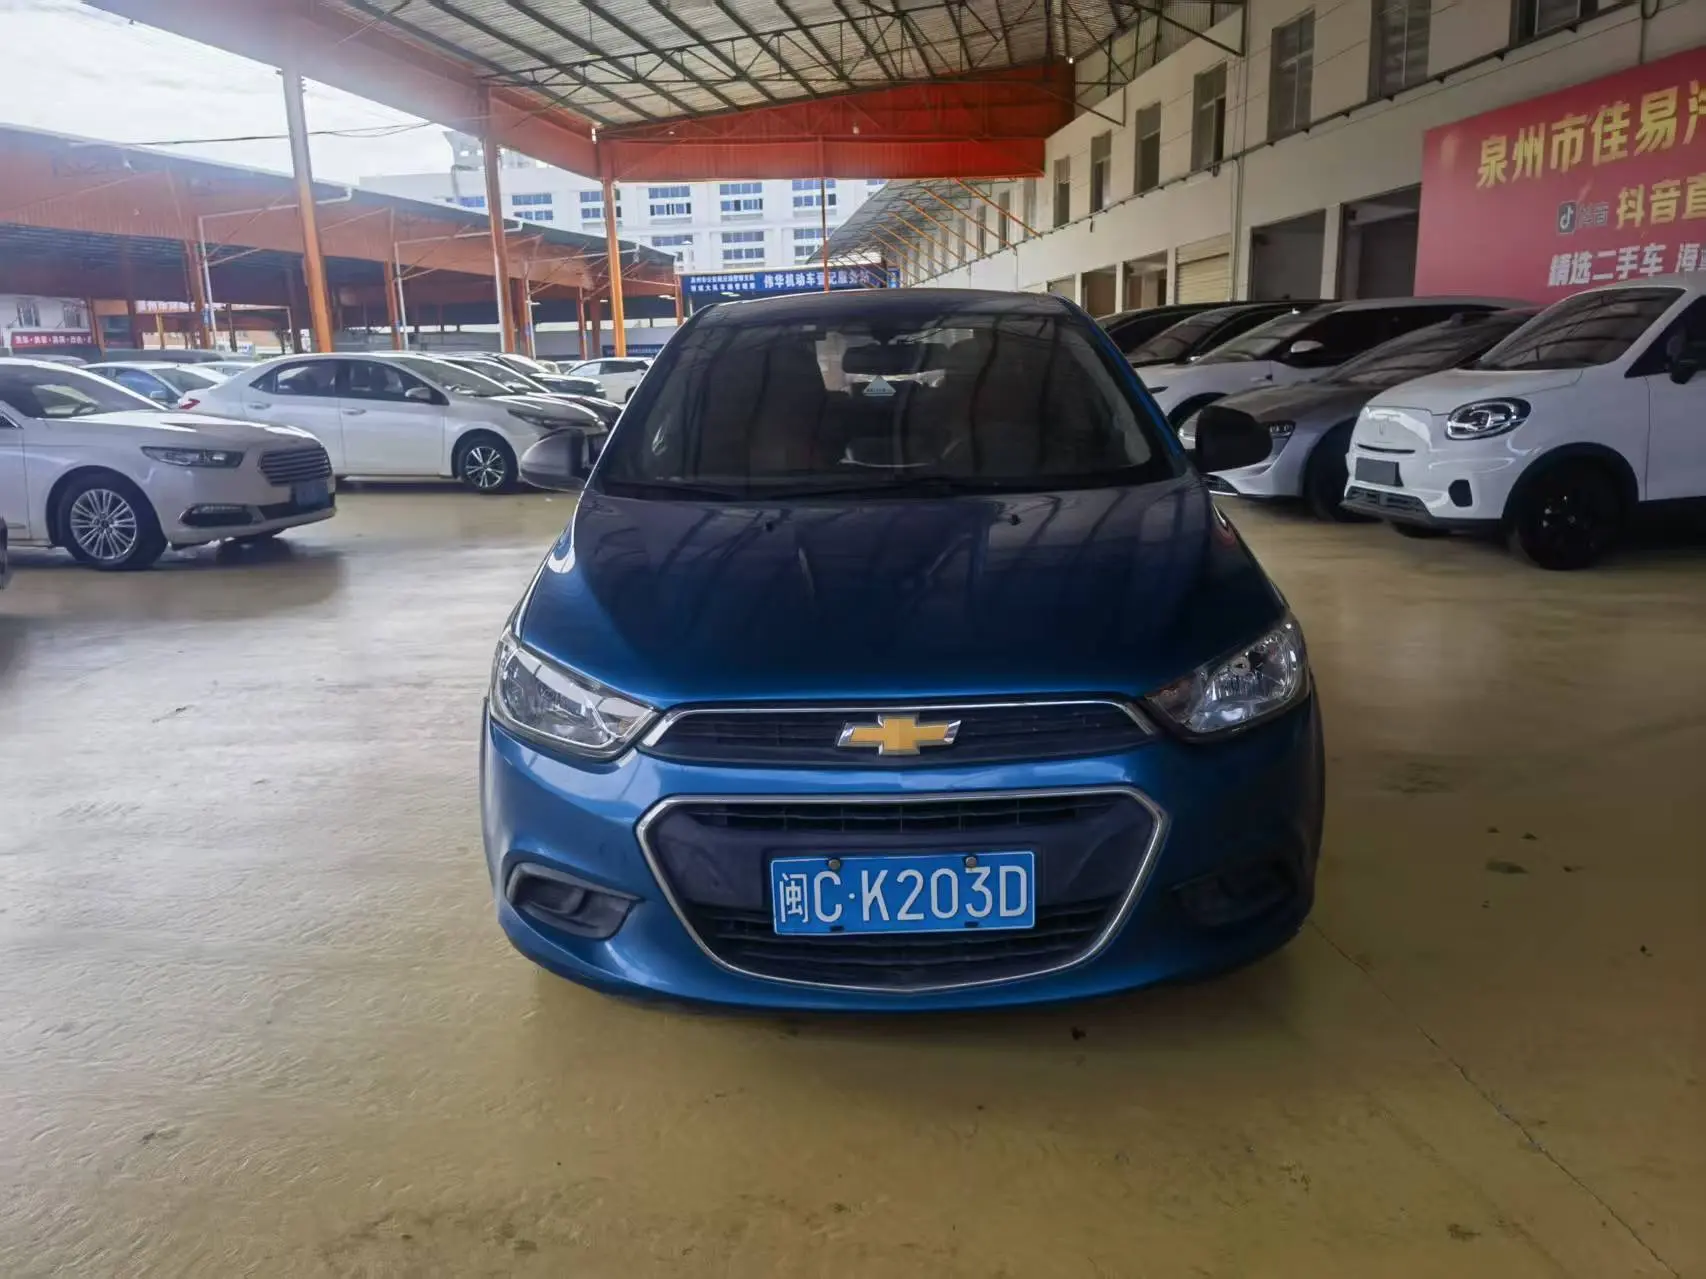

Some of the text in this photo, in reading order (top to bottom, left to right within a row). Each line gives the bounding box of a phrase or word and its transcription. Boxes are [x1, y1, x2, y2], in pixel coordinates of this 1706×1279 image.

[1548, 242, 1666, 286] 精选二手车
